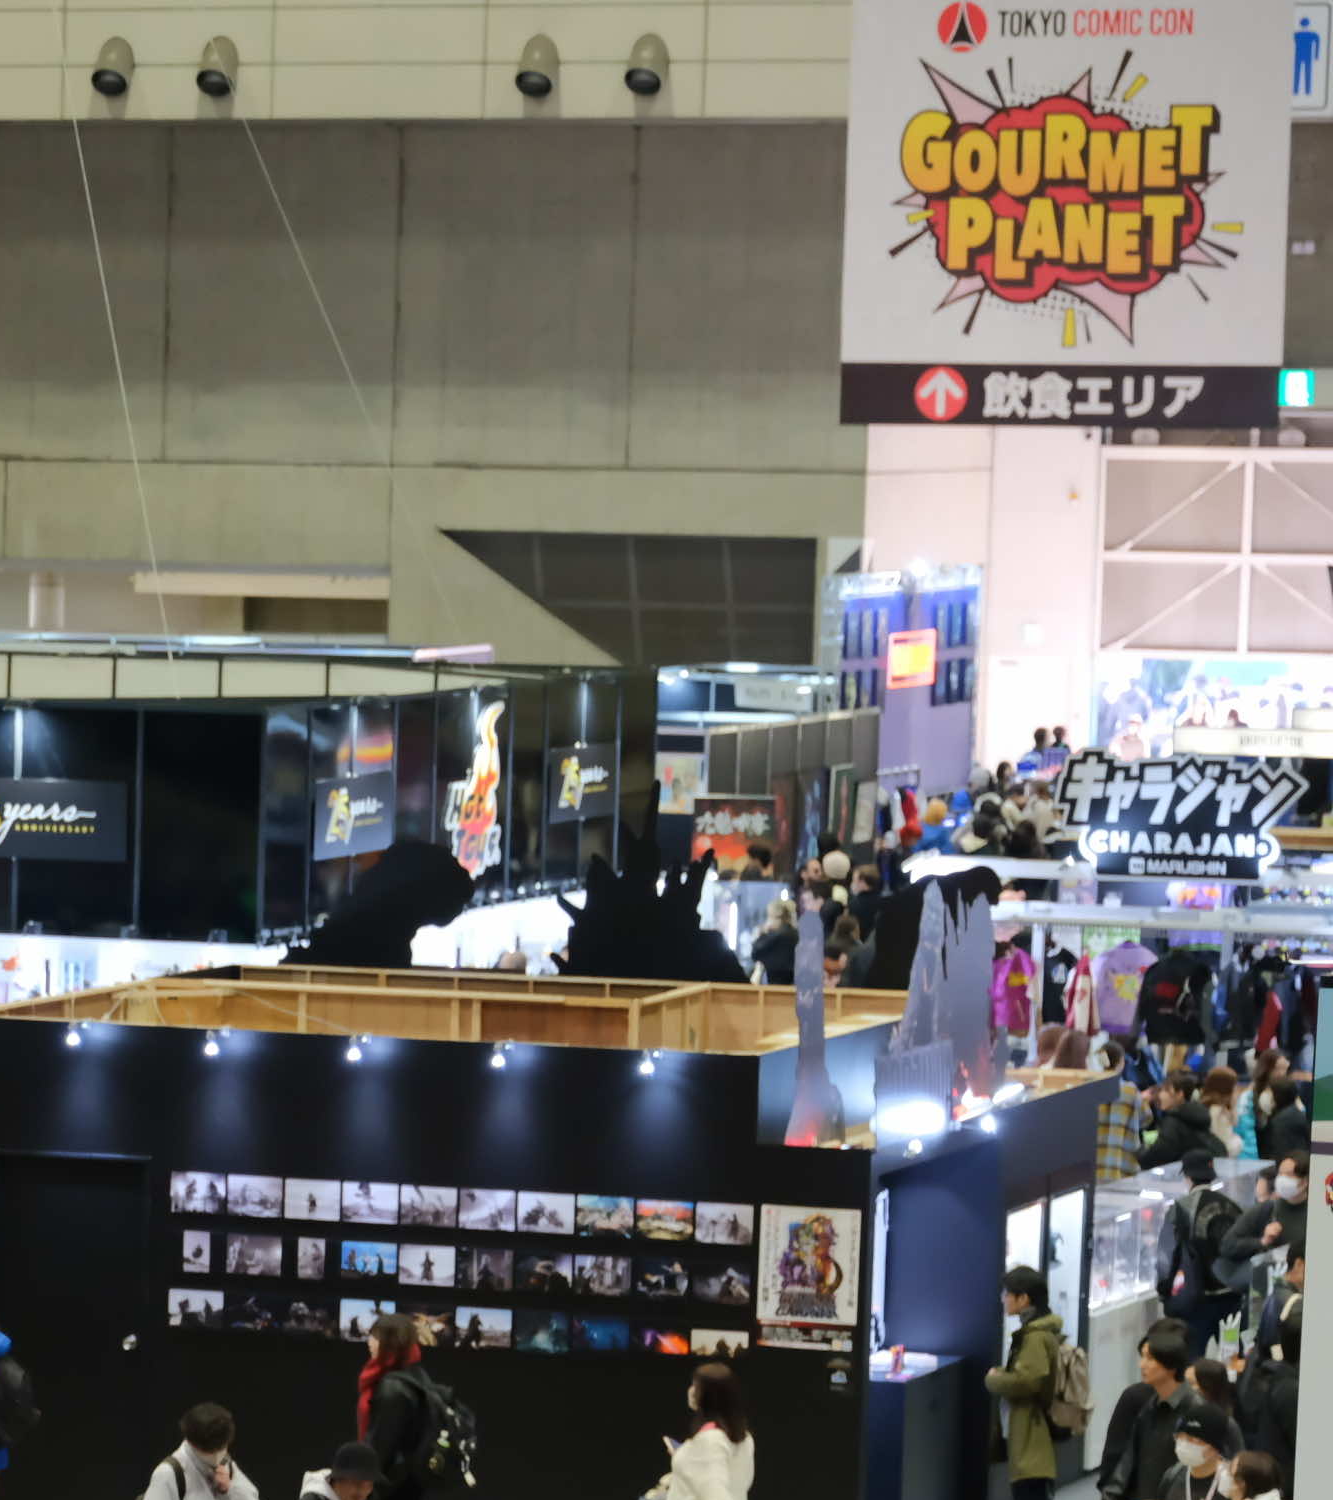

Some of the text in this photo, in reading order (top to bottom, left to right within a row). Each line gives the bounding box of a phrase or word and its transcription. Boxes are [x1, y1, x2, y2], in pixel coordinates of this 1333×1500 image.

[998, 9, 1195, 37] TOKYO COMIC CON
[900, 104, 1220, 196] GOURMET
[945, 195, 1186, 285] PLANET
[982, 371, 1205, 420] 飲食エリア
[1065, 754, 1295, 828] キャラジャン
